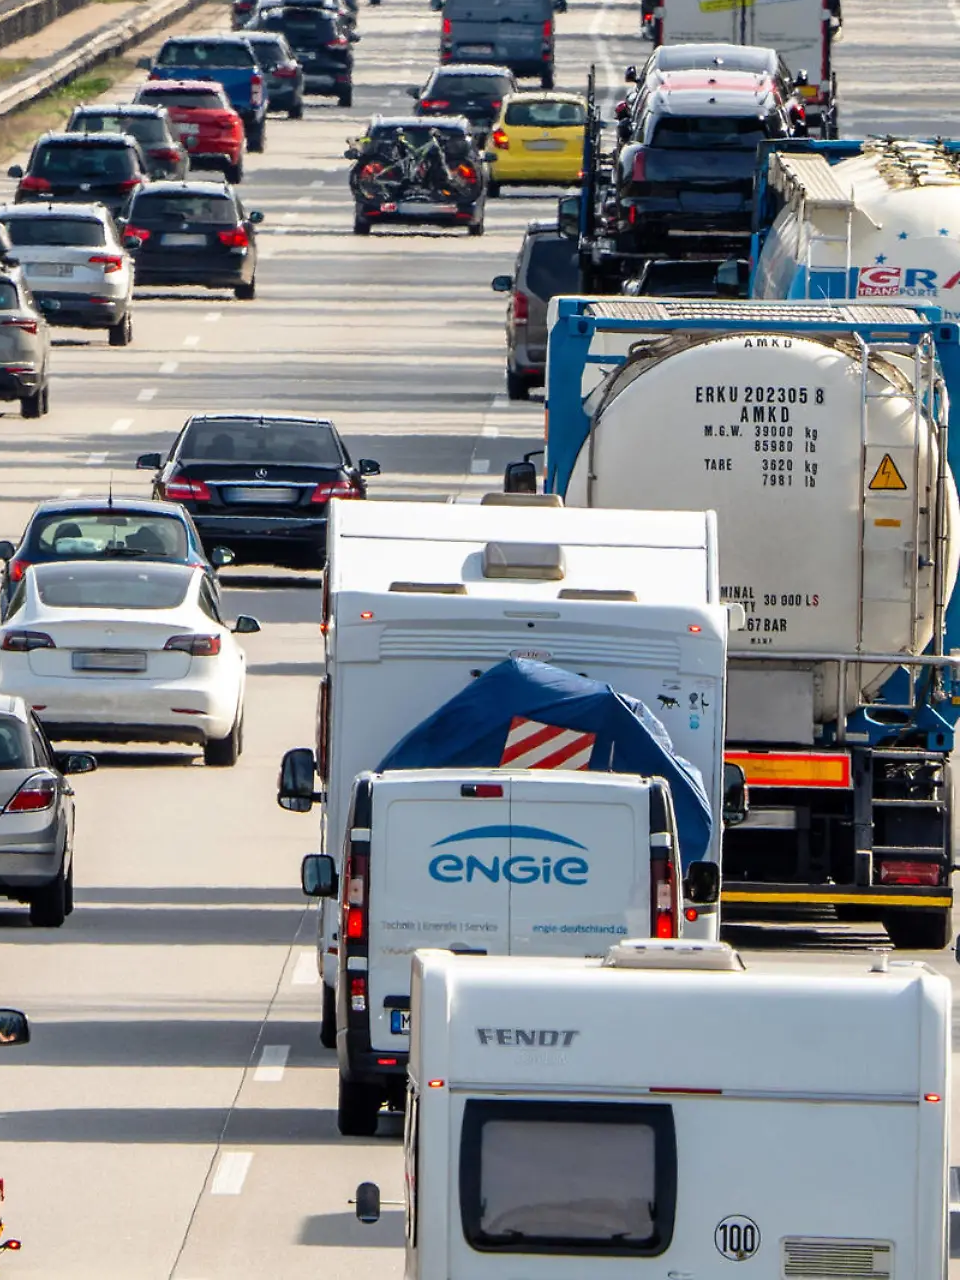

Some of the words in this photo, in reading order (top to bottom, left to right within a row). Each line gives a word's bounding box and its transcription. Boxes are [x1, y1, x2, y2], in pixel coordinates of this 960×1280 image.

[696, 386, 738, 403] ERKU
[744, 386, 808, 404] 202305
[815, 388, 824, 405] 8
[740, 406, 790, 423] AMKD
[704, 425, 743, 437] M.G.W.
[754, 426, 793, 437] 39000
[805, 427, 818, 441] kg
[754, 440, 793, 452] 85980
[805, 441, 816, 453] lb
[704, 458, 733, 470] TARE
[762, 459, 793, 470] 3620
[805, 460, 818, 475] kg
[762, 474, 793, 486] 7981
[805, 475, 816, 487] lb
[720, 586, 755, 599] MINAL
[763, 594, 777, 606] 30
[763, 618, 787, 632] BAR
[476, 1028, 580, 1048] FENDT
[719, 1224, 755, 1252] 100
